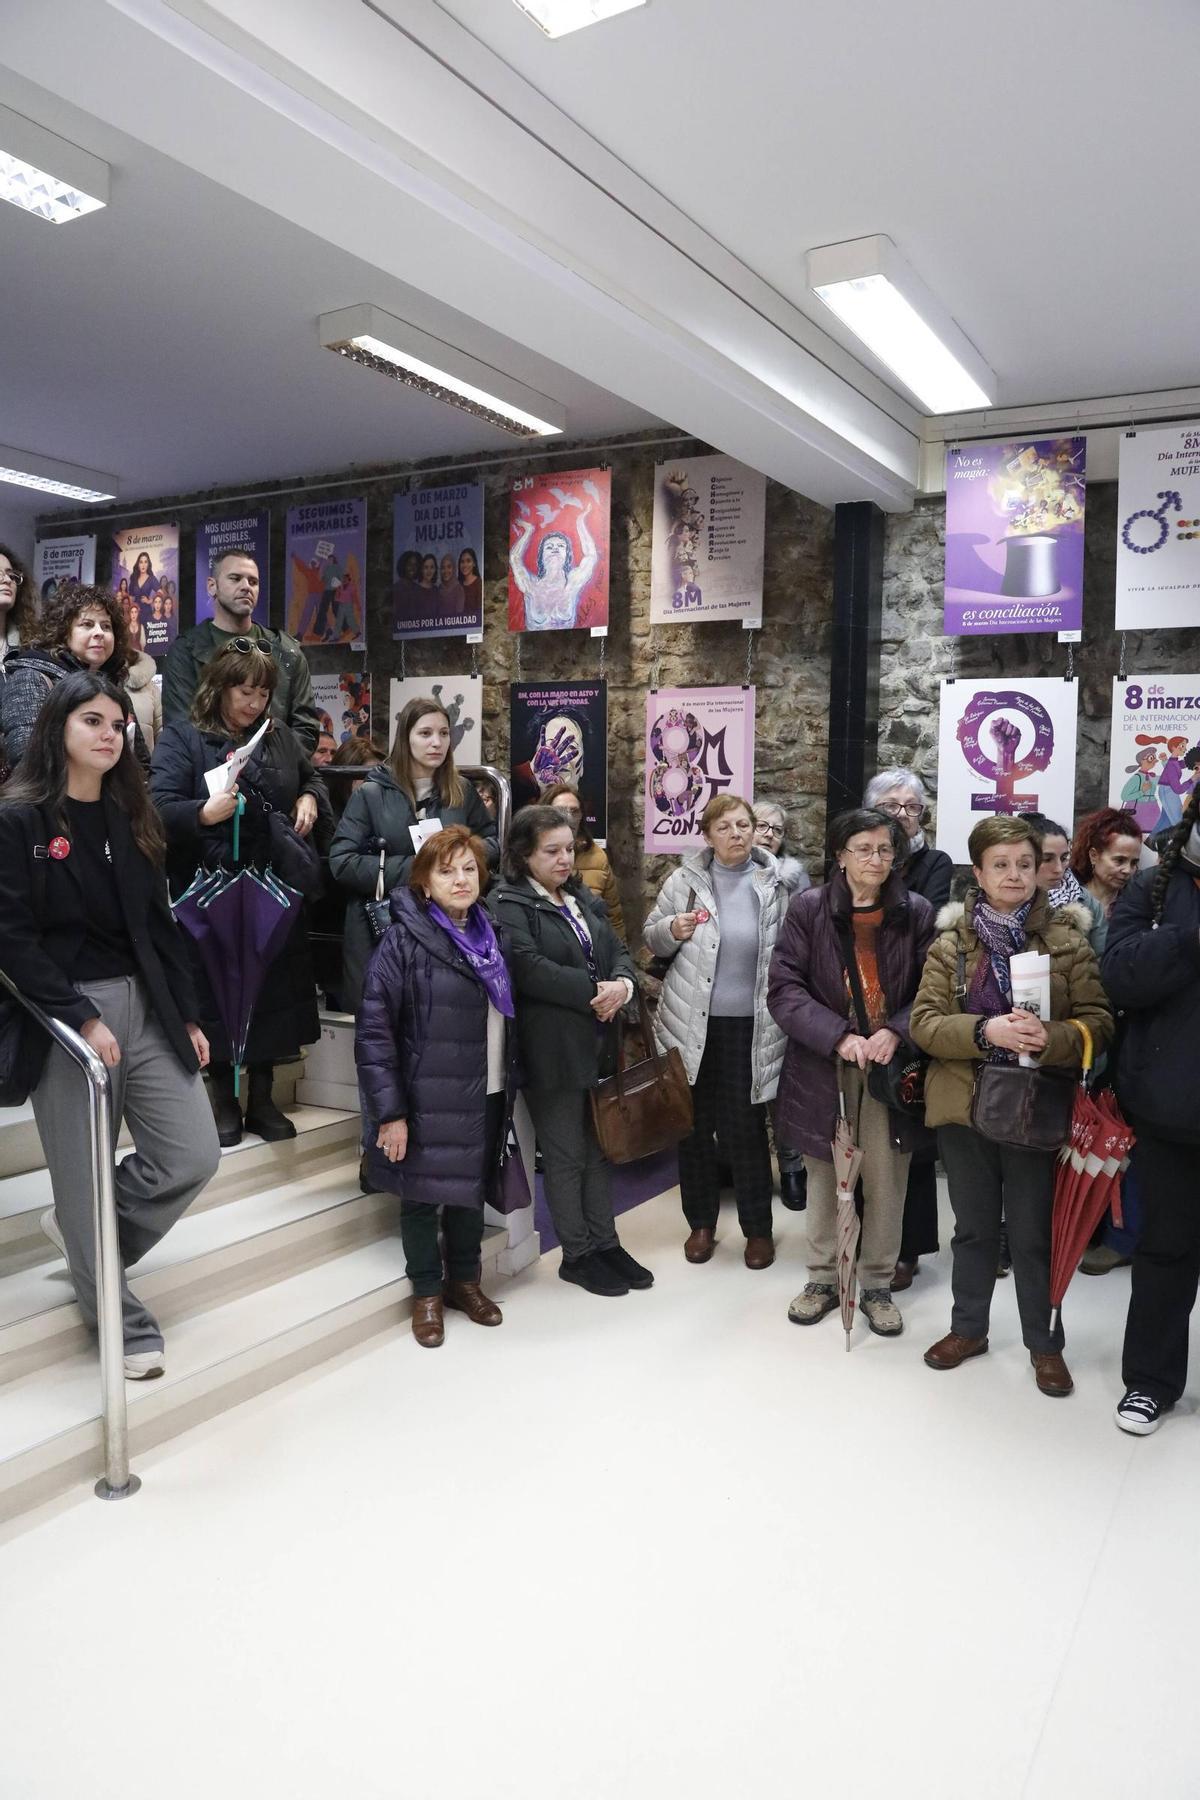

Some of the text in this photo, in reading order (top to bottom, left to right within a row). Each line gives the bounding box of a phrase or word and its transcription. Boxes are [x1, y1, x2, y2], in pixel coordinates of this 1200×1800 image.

[953, 456, 983, 468] No es
[1158, 451, 1173, 461] Día
[953, 467, 990, 480] magia:
[1170, 465, 1200, 476] MUJE
[512, 477, 534, 491] 8M
[411, 487, 468, 506] 8 DE MARZO
[298, 502, 353, 521] SEGUIMOS
[432, 506, 446, 520] DE
[448, 504, 461, 517] LA
[205, 517, 258, 534] NOS QUISIERON
[291, 515, 359, 536] IMPARABLES
[415, 520, 464, 543] MUJER
[127, 534, 163, 546] 8 de marzo
[210, 530, 251, 545] INVISIBLES.
[43, 548, 85, 560] 8 de marzo
[208, 546, 218, 557] NO
[243, 542, 257, 552] QUE
[672, 582, 702, 609] 8M
[673, 604, 710, 614] Internacional
[728, 601, 751, 609] Mujeres
[962, 603, 1062, 621] es conciliación.
[147, 621, 168, 630] Nuestro
[397, 615, 477, 630] UNIDAS POR LA IGUALDAD
[149, 629, 167, 637] tiempo
[1147, 684, 1165, 695] de
[1125, 684, 1143, 710] 8
[1140, 714, 1200, 722] INTERNACIONA
[1136, 723, 1152, 731] LAS
[1155, 723, 1188, 732] MUJERES
[652, 810, 703, 836] CONT
